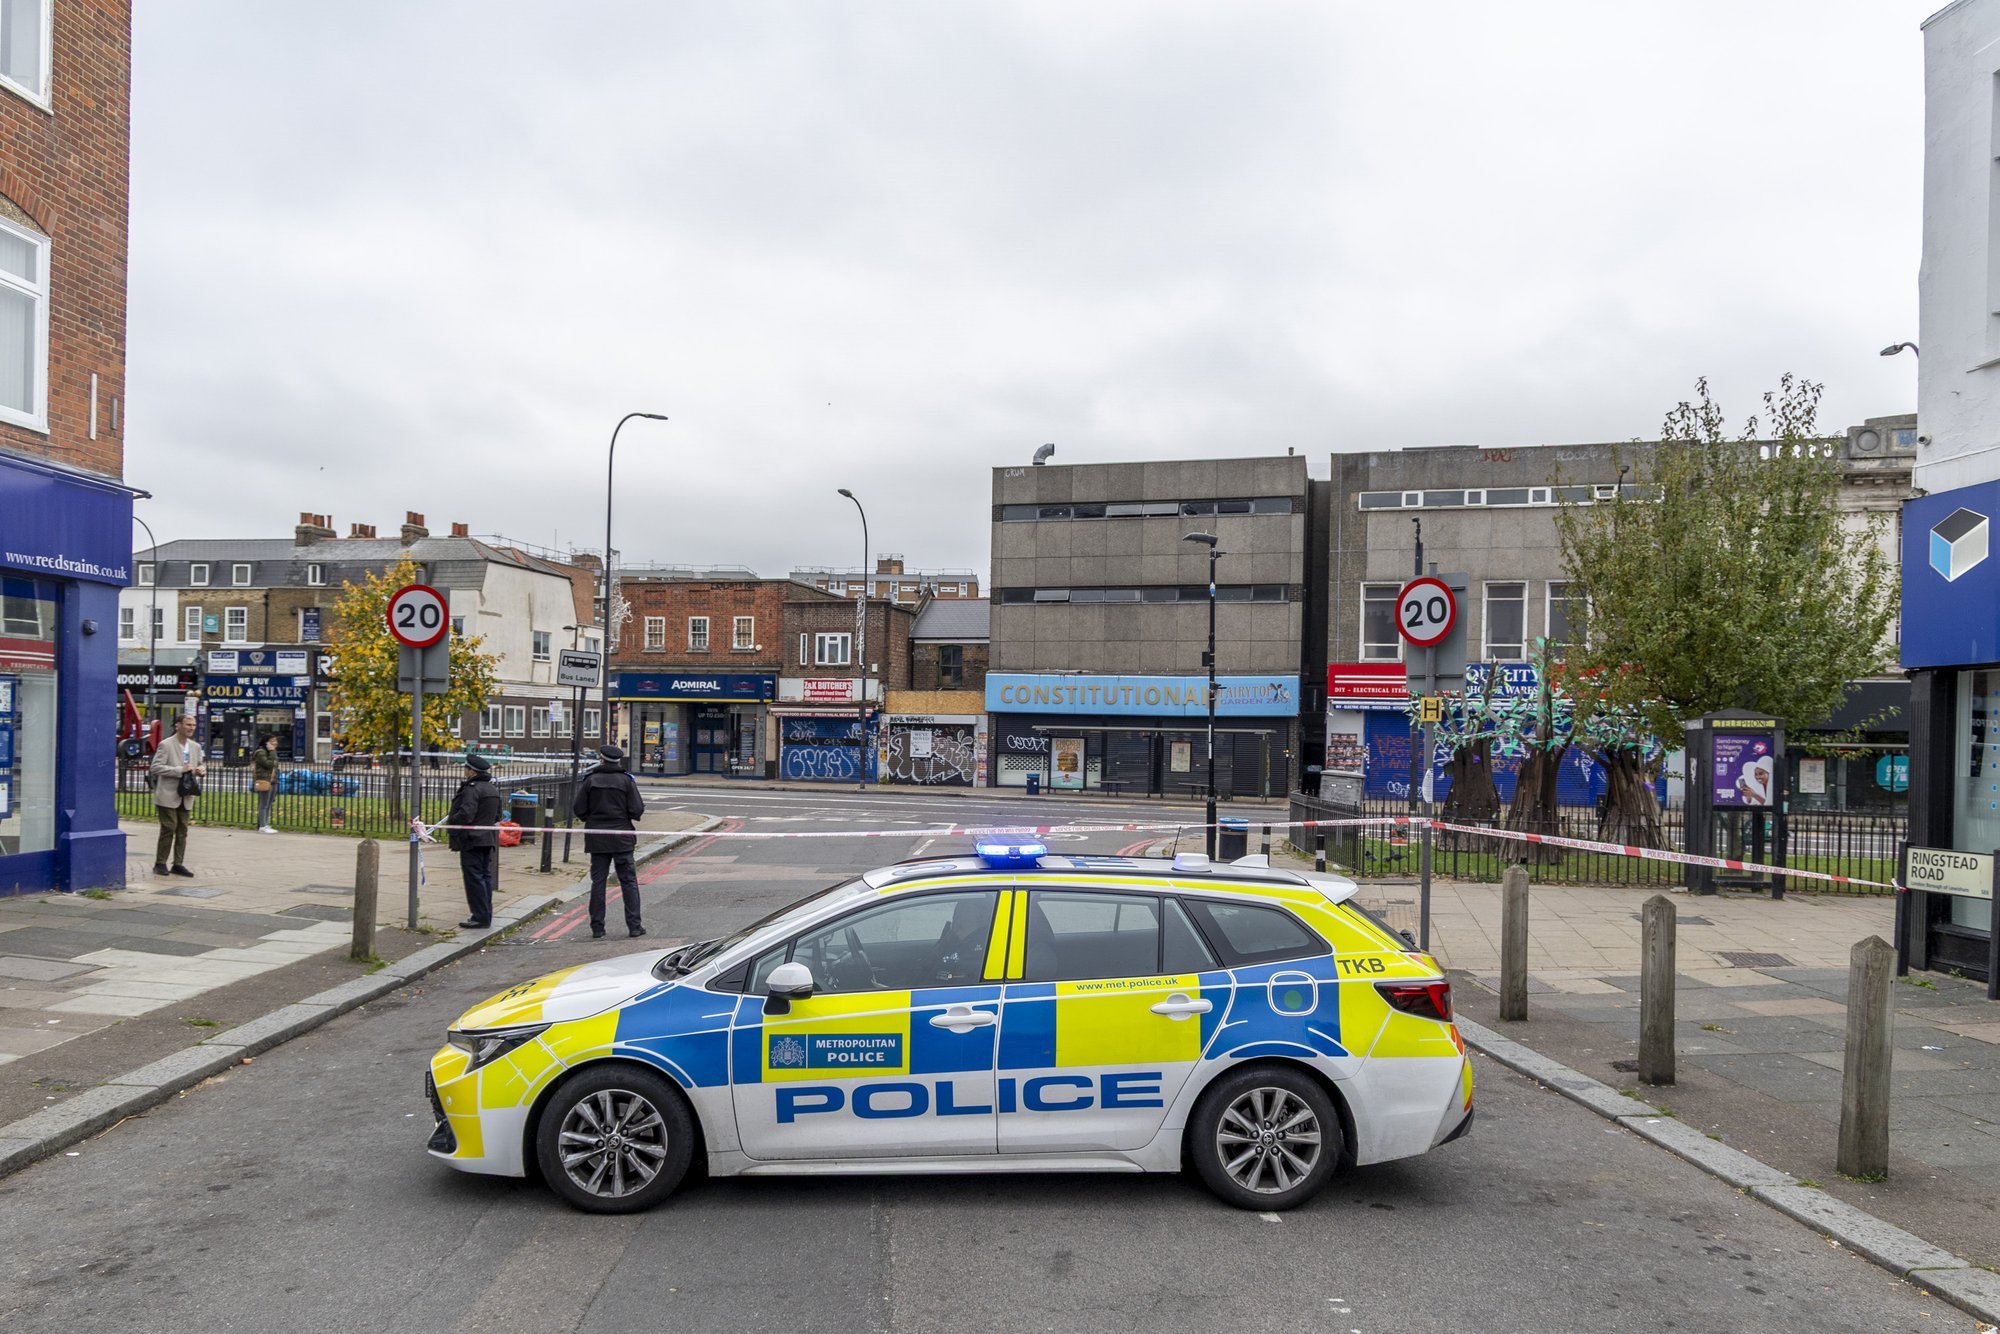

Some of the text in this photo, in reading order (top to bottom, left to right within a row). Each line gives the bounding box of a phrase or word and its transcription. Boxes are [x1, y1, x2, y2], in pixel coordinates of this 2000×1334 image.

[5, 552, 128, 580] www.reedsrains.co.uk
[397, 603, 440, 629] 20
[1404, 596, 1447, 628] 20
[237, 677, 270, 685] WE BUY
[575, 674, 596, 683] Lanes
[1466, 668, 1539, 684] QULITY
[207, 685, 303, 698] GOLD & SILVER
[671, 680, 720, 690] ADMIRAL
[818, 681, 853, 691] BUTCHER'S
[1505, 685, 1538, 695] WARES
[1424, 700, 1440, 719] H
[1720, 720, 1768, 728] TELEPHONE
[1547, 837, 1566, 845] POLICE
[1600, 844, 1618, 852] CROSS
[1647, 850, 1665, 858] POLICE
[1701, 857, 1719, 865] CROSS
[1912, 852, 1979, 870] RINGSTEAD
[1911, 866, 1945, 881] ROAD
[1337, 957, 1385, 974] TKB
[1076, 977, 1178, 991] www.met.police.uk
[816, 1039, 896, 1048] METROPOLITAN
[827, 1052, 885, 1062] POLICE
[776, 1072, 1163, 1123] POLICE
